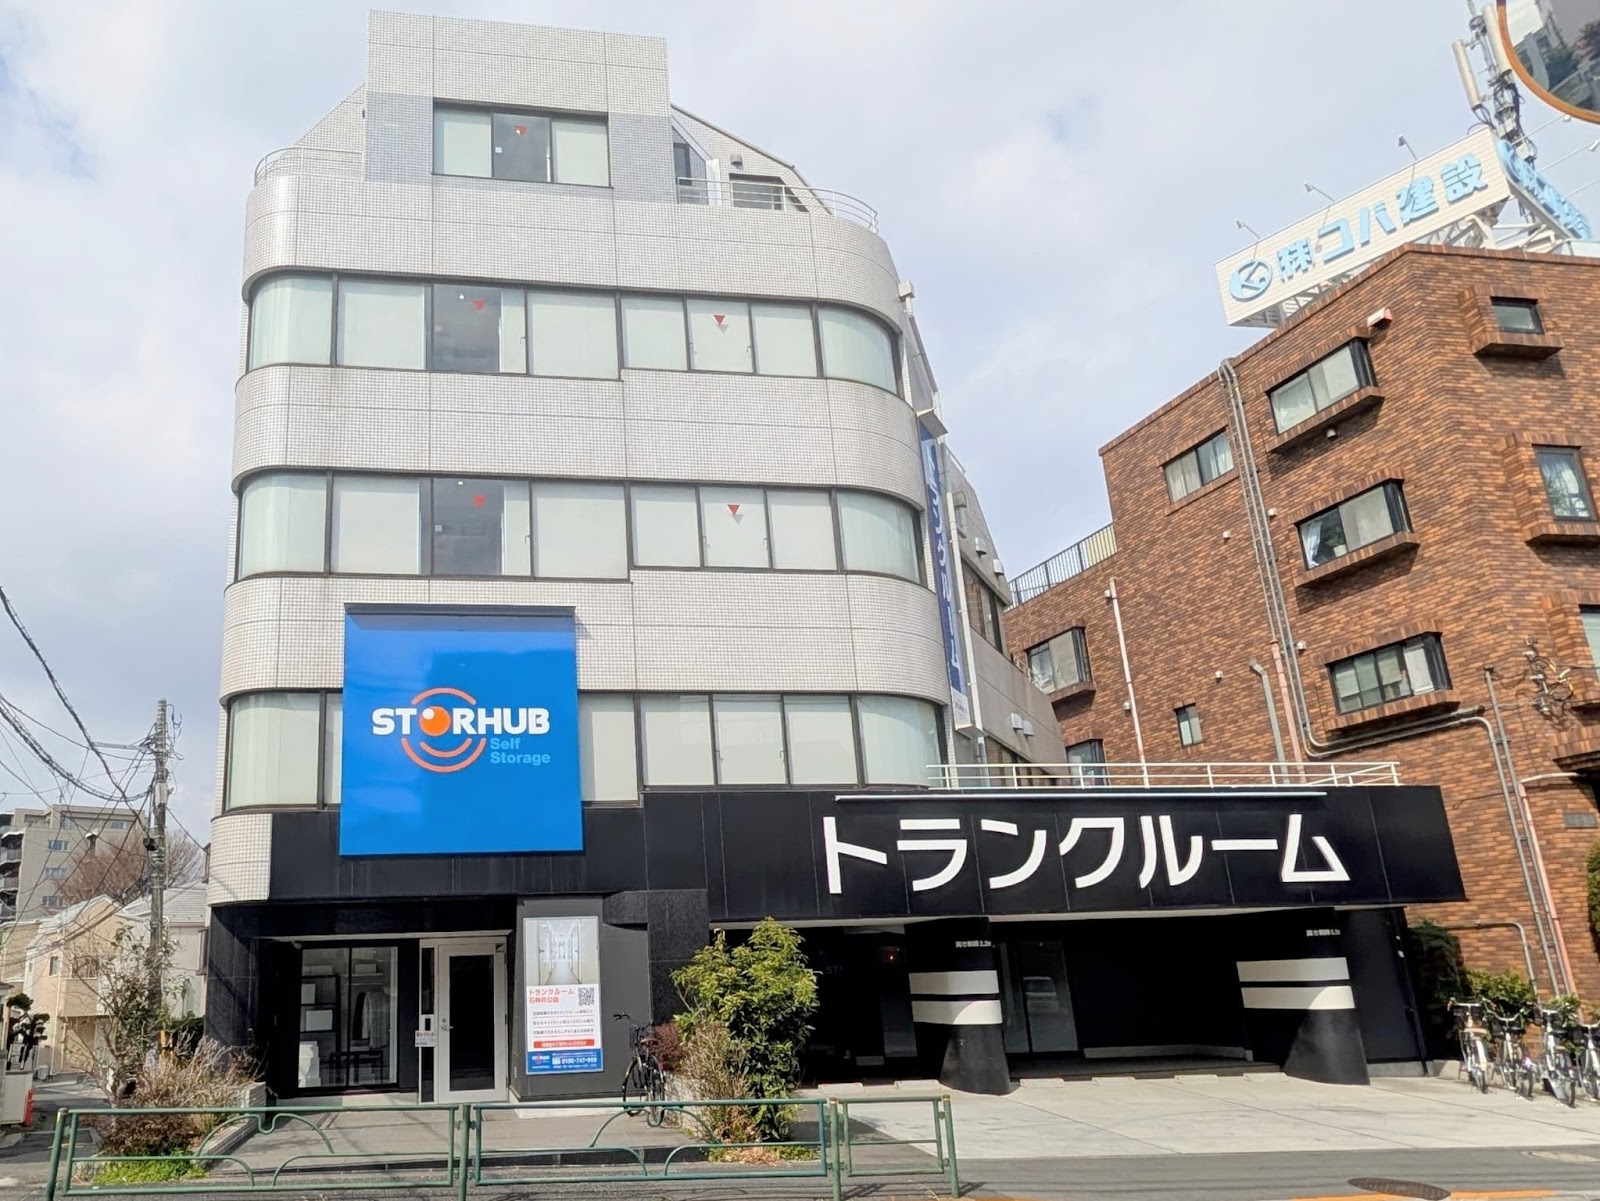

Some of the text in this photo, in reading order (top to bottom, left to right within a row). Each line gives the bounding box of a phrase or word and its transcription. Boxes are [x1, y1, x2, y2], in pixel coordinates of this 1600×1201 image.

[372, 706, 550, 736] STORHUB
[490, 738, 521, 751] Self
[490, 752, 551, 766] Storage
[823, 813, 1350, 894] トランクルーム
[529, 988, 575, 996] トランクルーム
